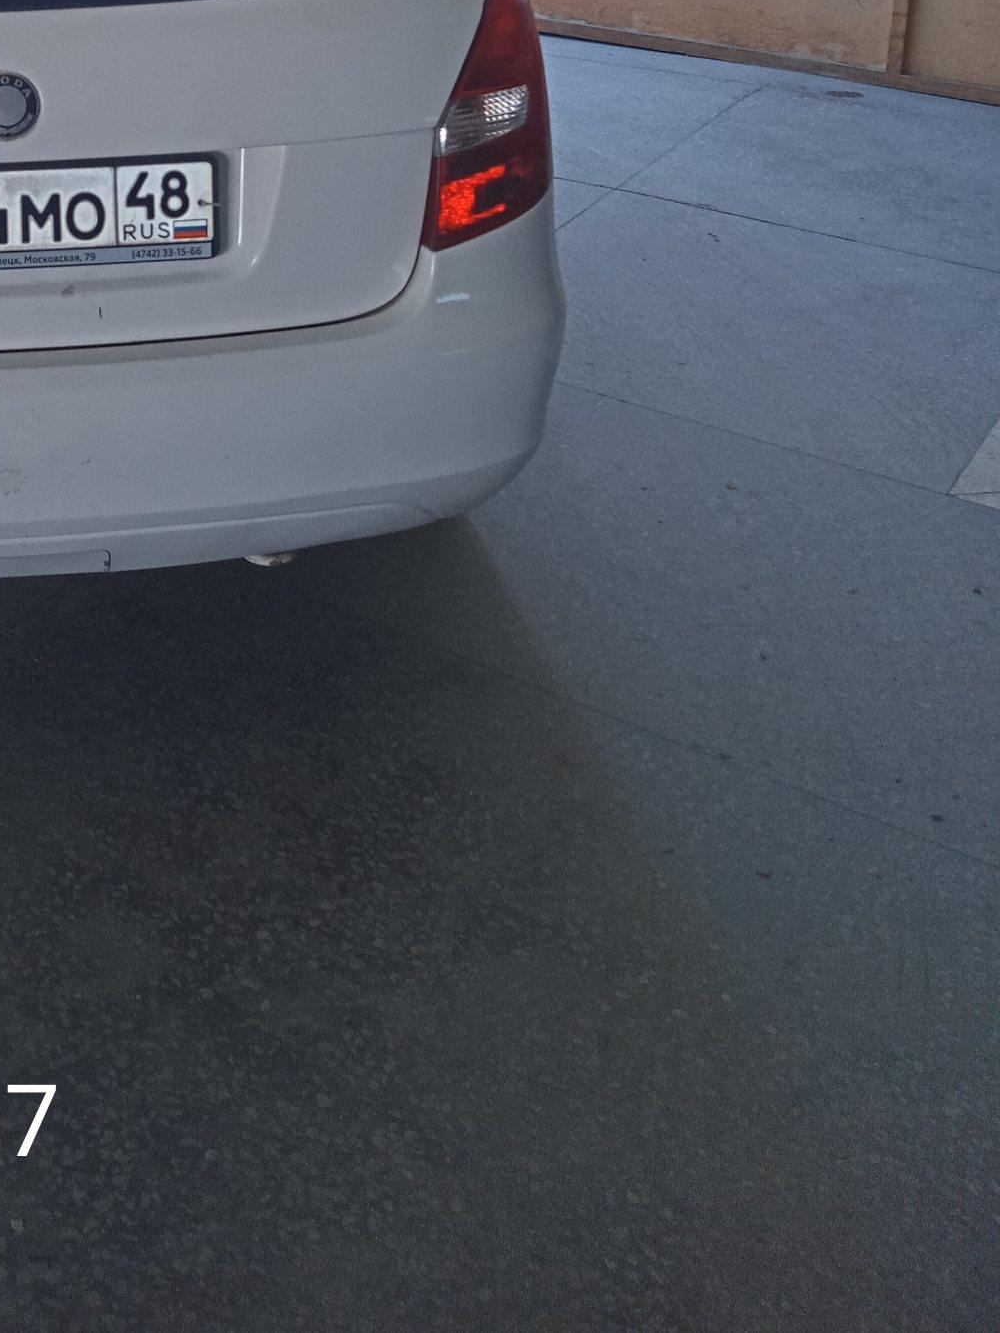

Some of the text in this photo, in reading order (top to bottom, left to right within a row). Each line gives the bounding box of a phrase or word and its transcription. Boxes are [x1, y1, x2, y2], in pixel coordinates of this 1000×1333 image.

[126, 170, 190, 220] 48
[123, 222, 170, 241] RUS
[84, 252, 96, 262] 79
[132, 246, 202, 259] (4742) 33-15-66
